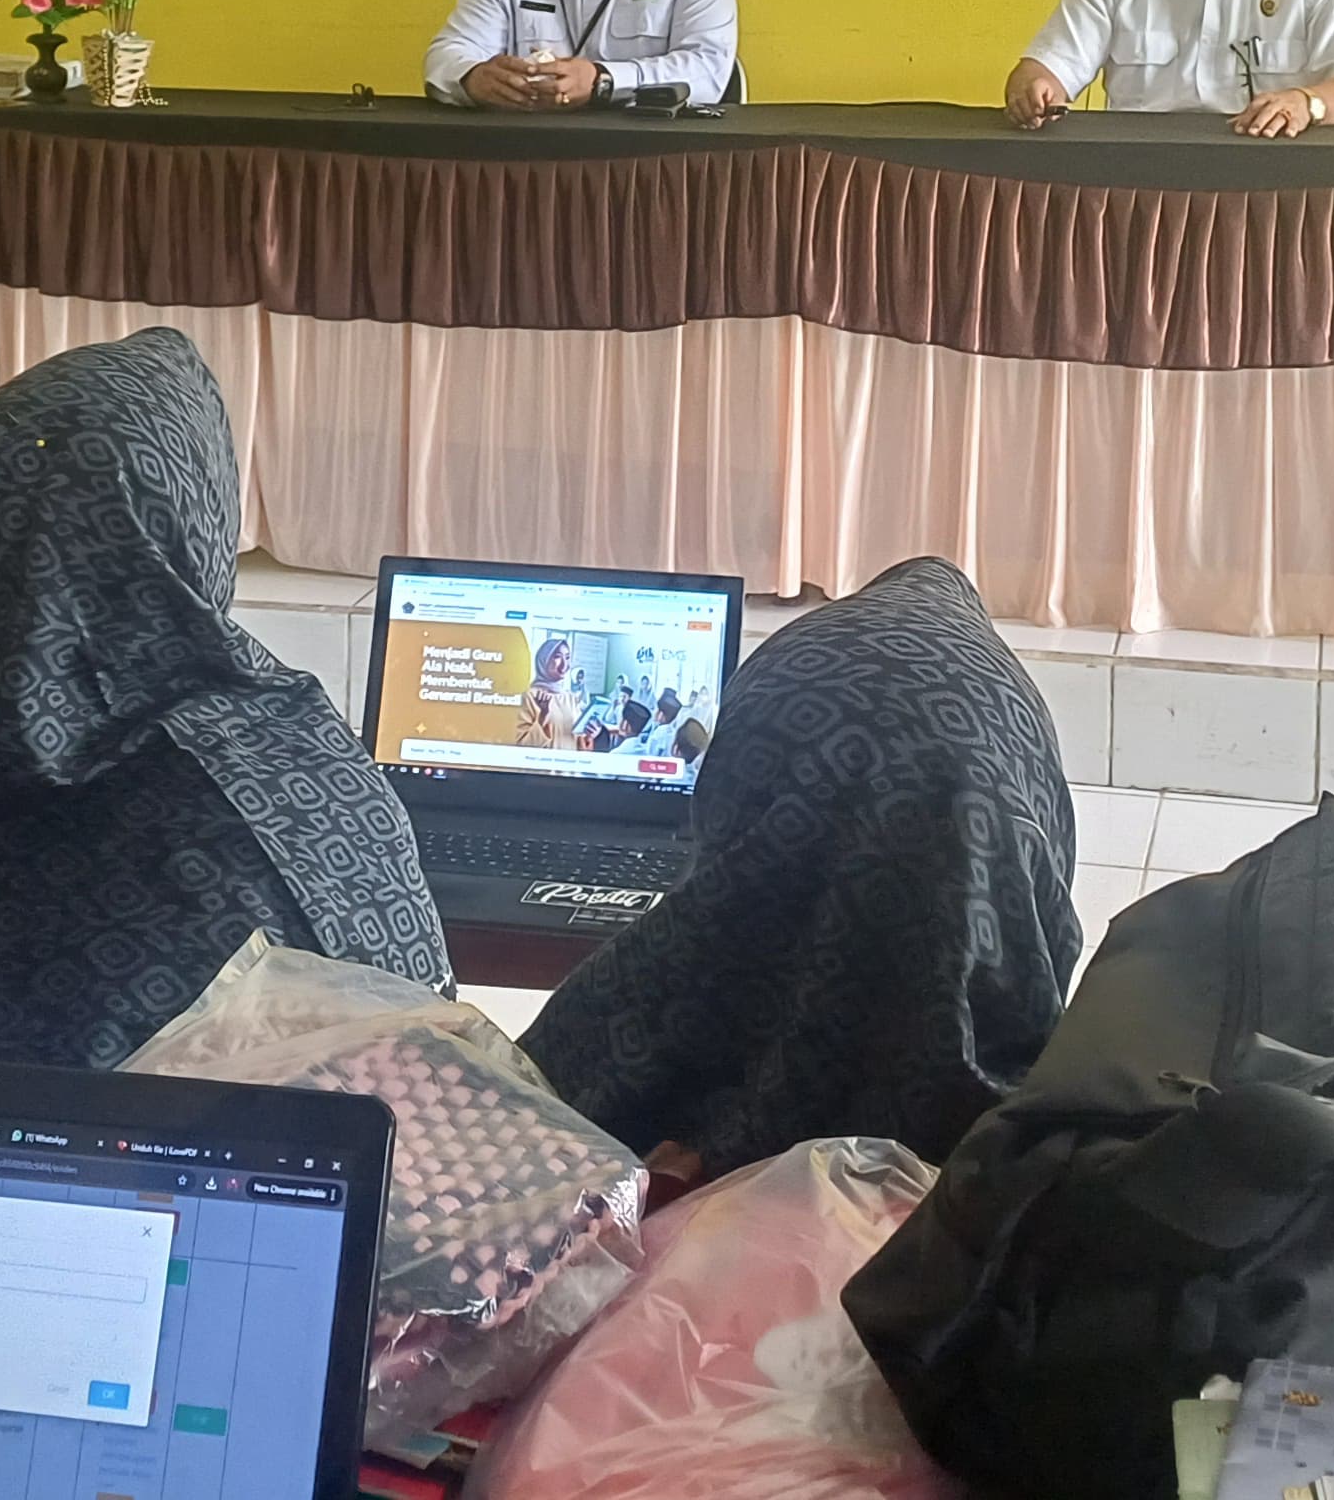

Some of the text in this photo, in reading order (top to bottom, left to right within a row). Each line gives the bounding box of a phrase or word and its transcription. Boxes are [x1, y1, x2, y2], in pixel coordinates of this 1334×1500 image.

[422, 645, 503, 663] Menjadi Guru
[420, 674, 493, 691] Membentuk
[419, 687, 471, 703] Generasi
